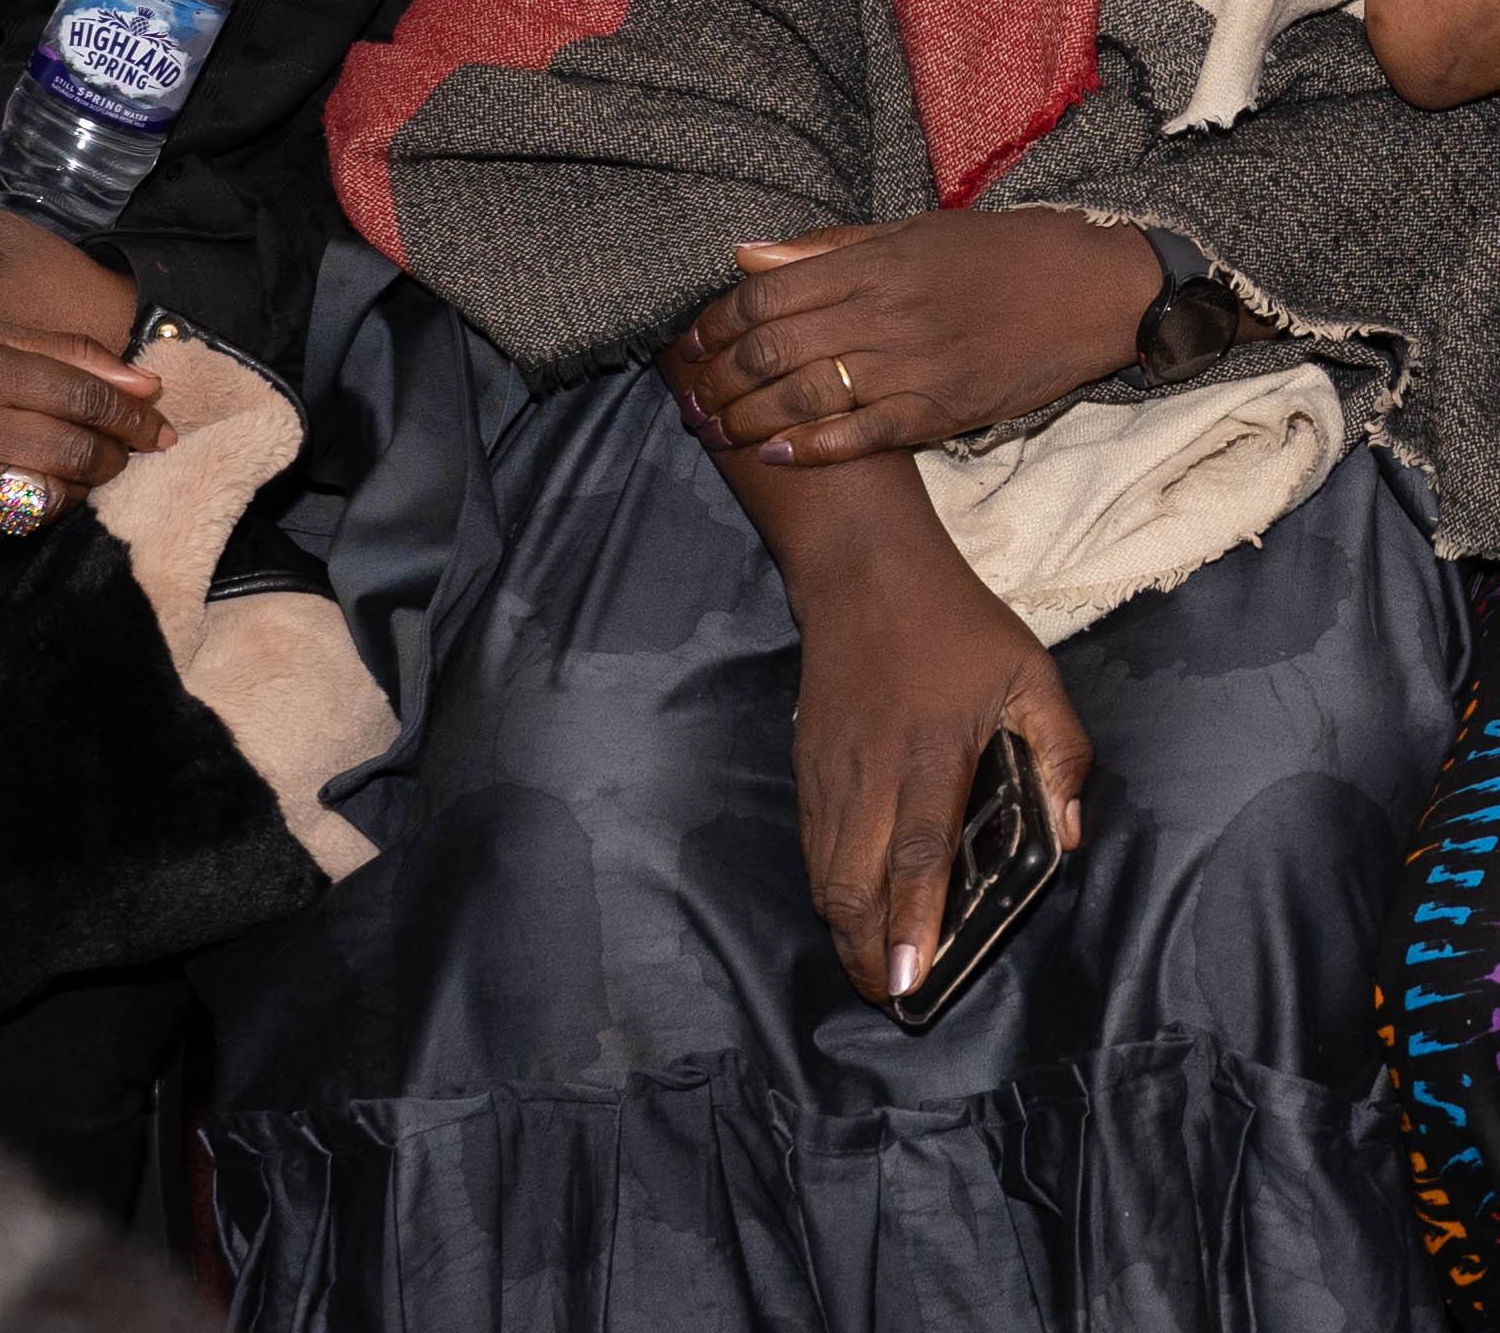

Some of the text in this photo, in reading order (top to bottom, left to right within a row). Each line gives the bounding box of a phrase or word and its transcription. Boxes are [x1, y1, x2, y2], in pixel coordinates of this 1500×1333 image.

[68, 21, 181, 88] HIGHLAND
[83, 50, 149, 90] SPRING
[53, 76, 75, 93] STILL
[76, 86, 123, 113] SPRING
[123, 109, 149, 122] WATER
